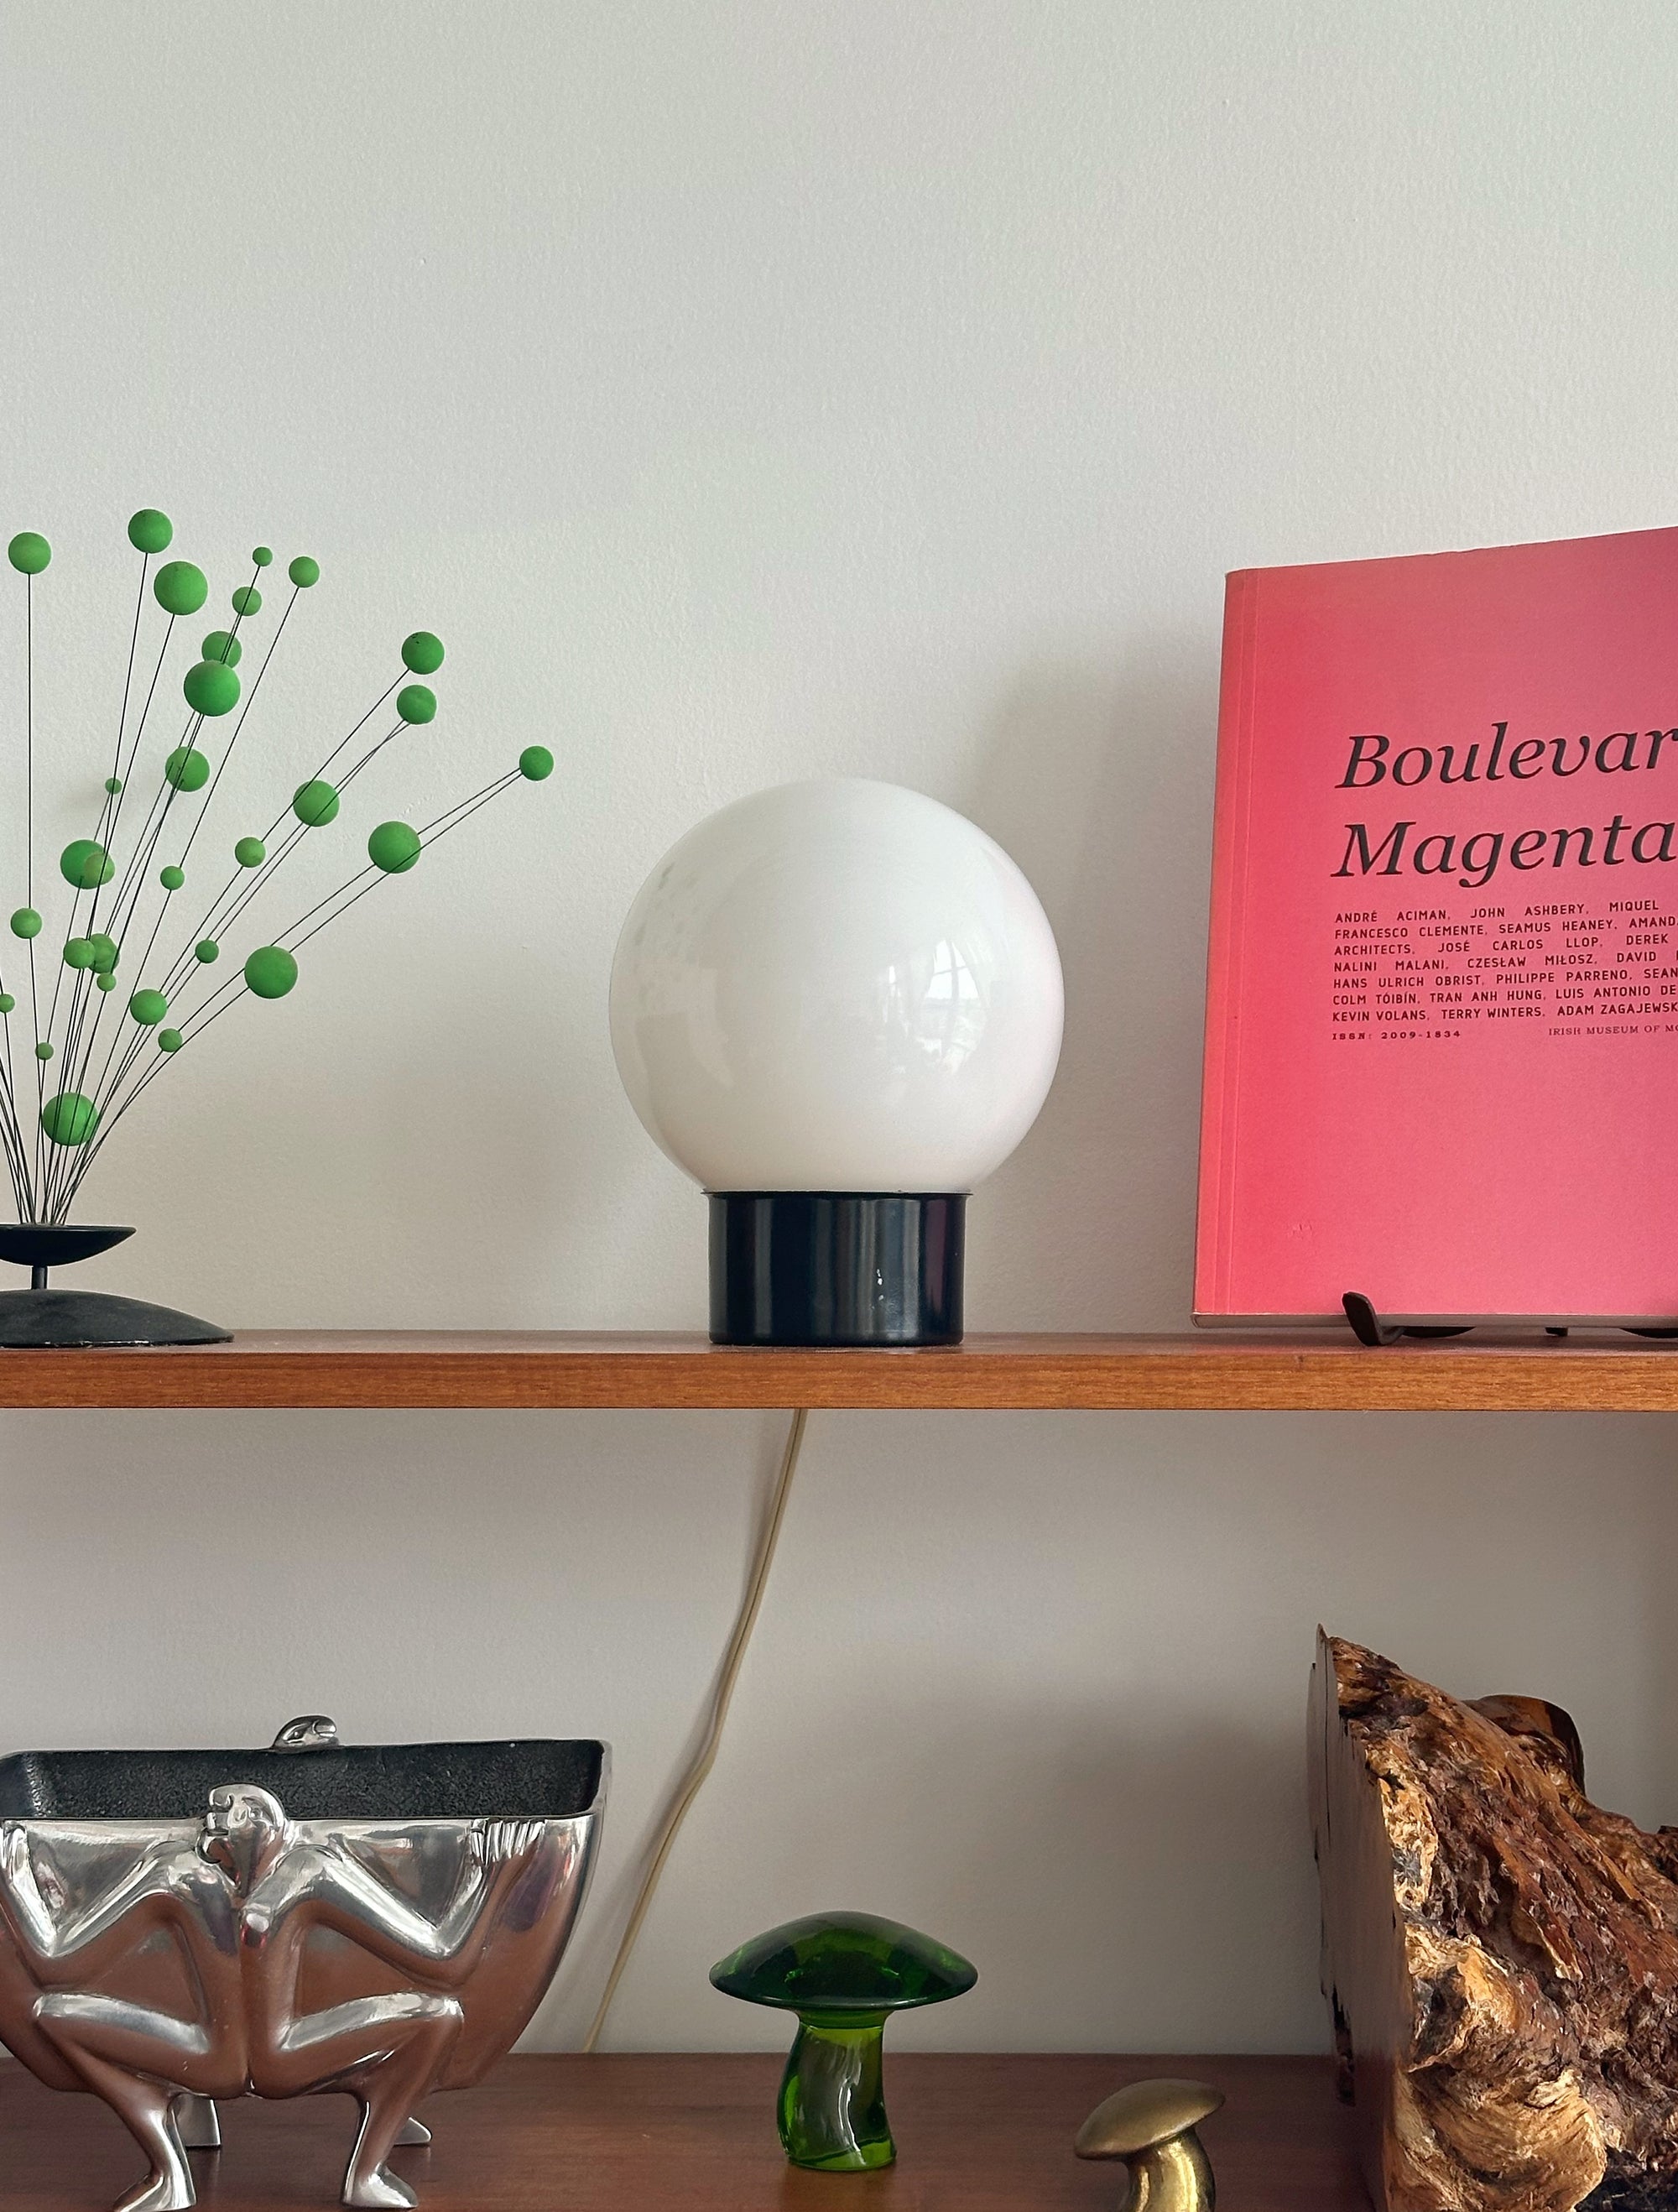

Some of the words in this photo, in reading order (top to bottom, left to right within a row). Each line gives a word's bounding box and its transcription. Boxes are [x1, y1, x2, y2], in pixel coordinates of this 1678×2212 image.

[1331, 815, 1676, 889] Magenta
[1335, 910, 1378, 923] ANDRÉ
[1471, 907, 1505, 919] JOHN
[1609, 900, 1659, 912] MIQUEL
[1335, 927, 1408, 939] FRANCESCO
[1499, 922, 1551, 934] SEAMUS
[1629, 916, 1678, 928] AMAND
[1438, 940, 1470, 952] JOSÉ
[1493, 939, 1544, 951] CARLOS
[1626, 933, 1669, 946] DEREK
[1334, 962, 1377, 972] NALINI
[1467, 957, 1526, 968] CZESŁAW
[1617, 951, 1657, 963] DAVID
[1333, 978, 1368, 989] HANS
[1378, 977, 1424, 987] ULRICH
[1496, 972, 1555, 983] PHILIPPE
[1644, 967, 1678, 979] SEAN
[1332, 995, 1366, 1005] COLM
[1430, 992, 1462, 1003] TRAN
[1471, 990, 1498, 1002] ANH
[1556, 988, 1584, 999] LUIS
[1593, 985, 1650, 998] ANTONIO
[1660, 983, 1676, 995] DE
[1332, 1011, 1369, 1022] KEVIN
[1441, 1008, 1481, 1020] TERRY
[1557, 1005, 1594, 1016] ADAM
[1381, 1030, 1461, 1040] 2009-1834
[1549, 1027, 1581, 1036] IRISH
[1587, 1025, 1639, 1035] MUSEUM
[1644, 1025, 1660, 1033] OF
